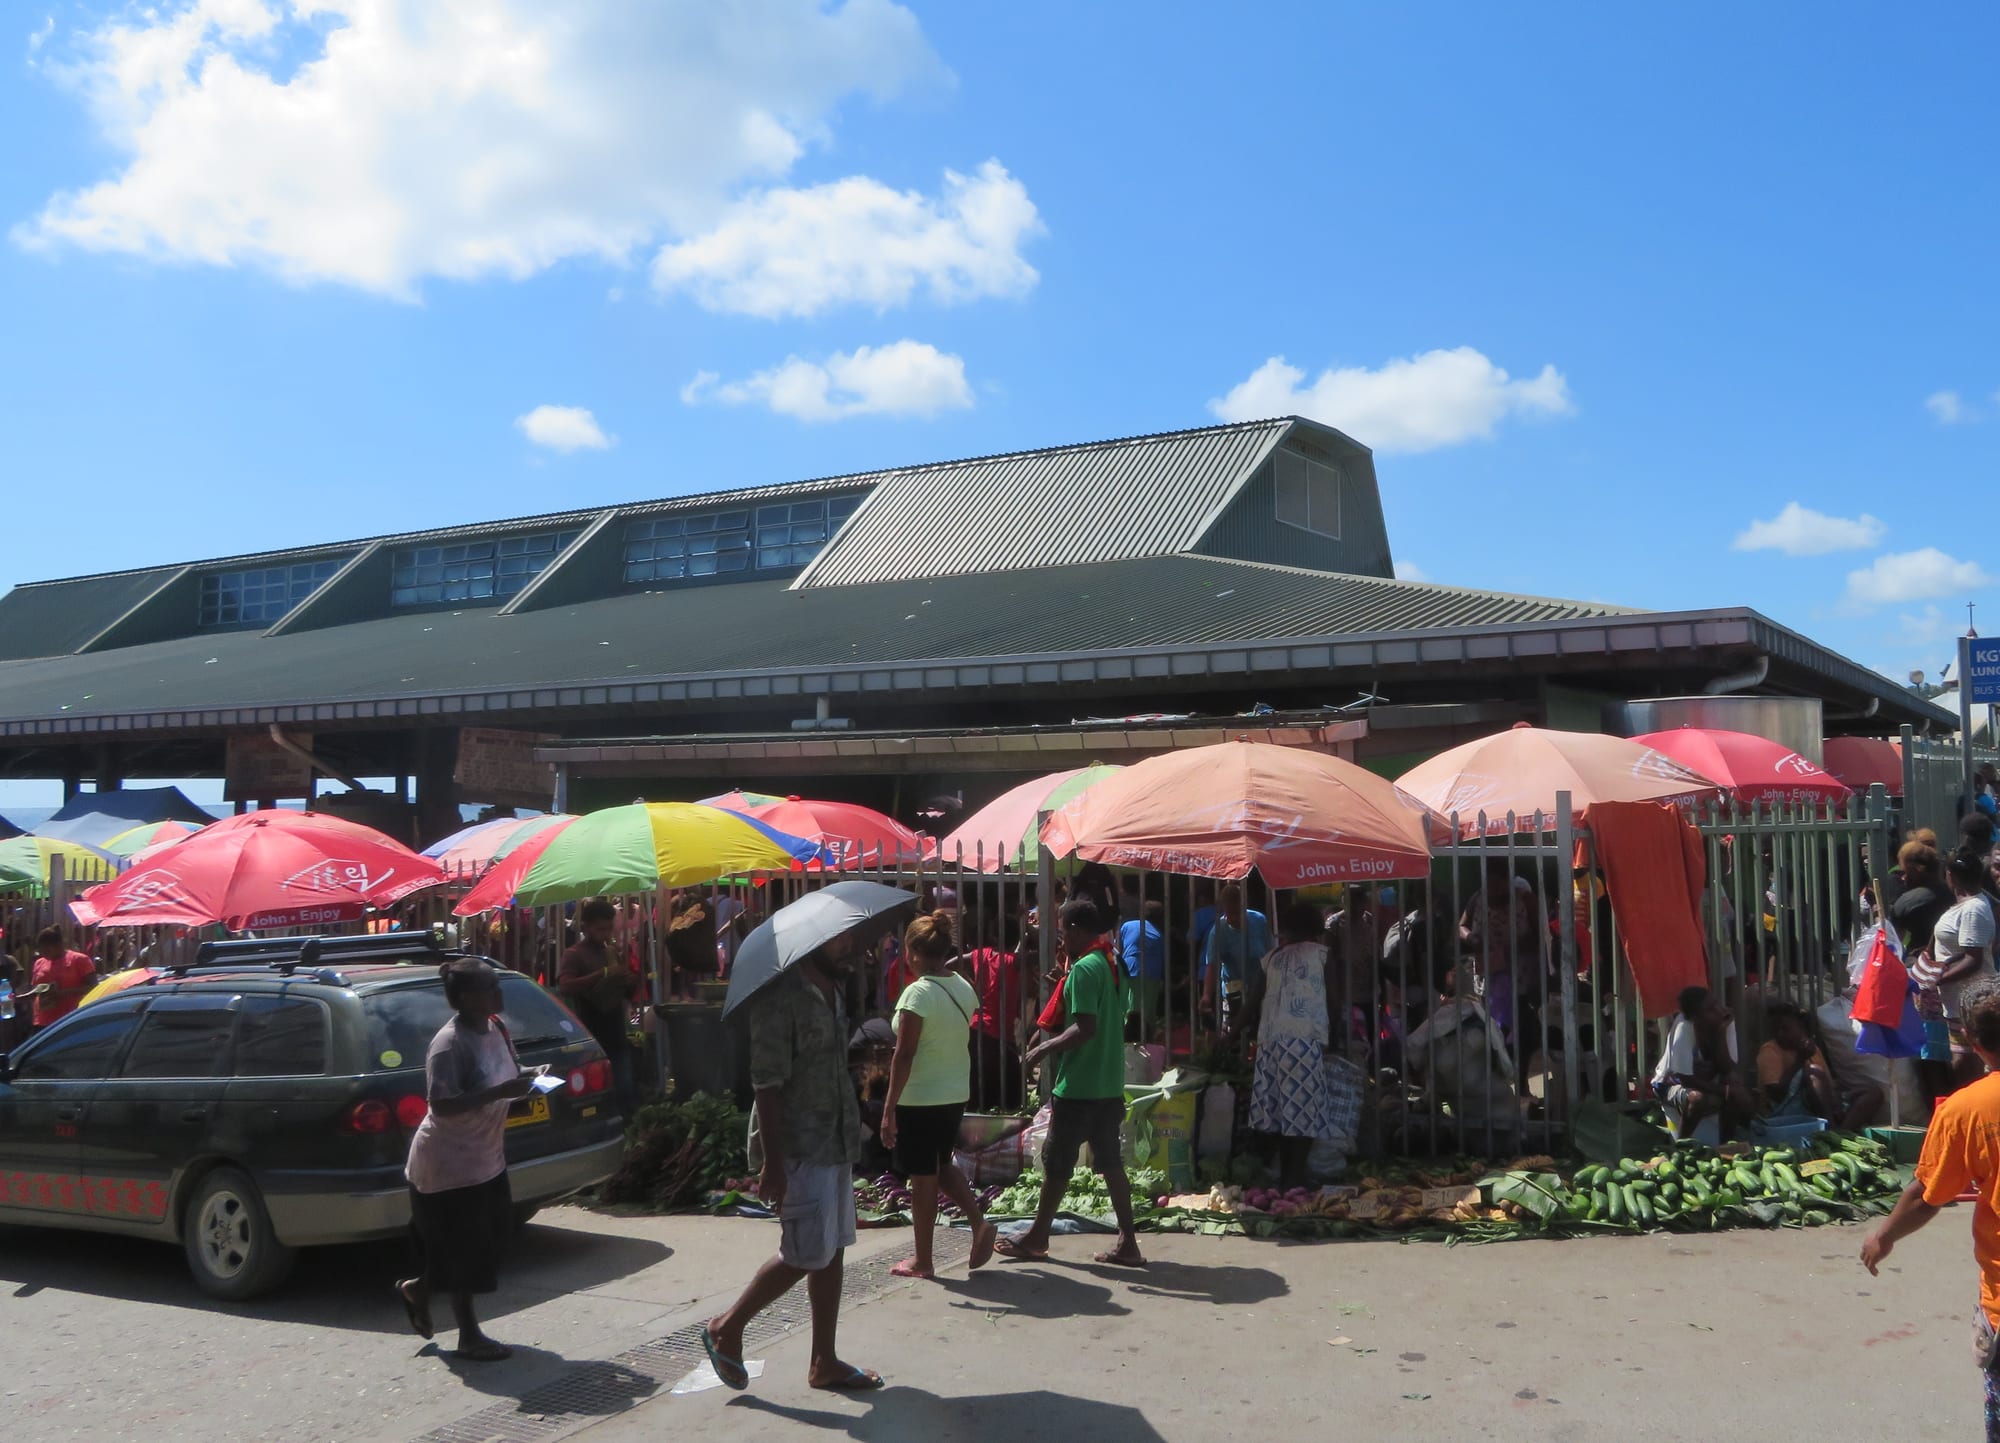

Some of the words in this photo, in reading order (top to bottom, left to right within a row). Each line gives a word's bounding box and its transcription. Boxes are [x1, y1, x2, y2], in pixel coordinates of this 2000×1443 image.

[1976, 650, 2000, 662] KG
[1974, 686, 1994, 694] BUS
[1762, 788, 1784, 799] John
[1166, 850, 1215, 872] Enjoy
[1296, 863, 1337, 879] John
[1350, 858, 1394, 874] Enjoy
[251, 914, 287, 928] John
[301, 908, 341, 922] Enjoy
